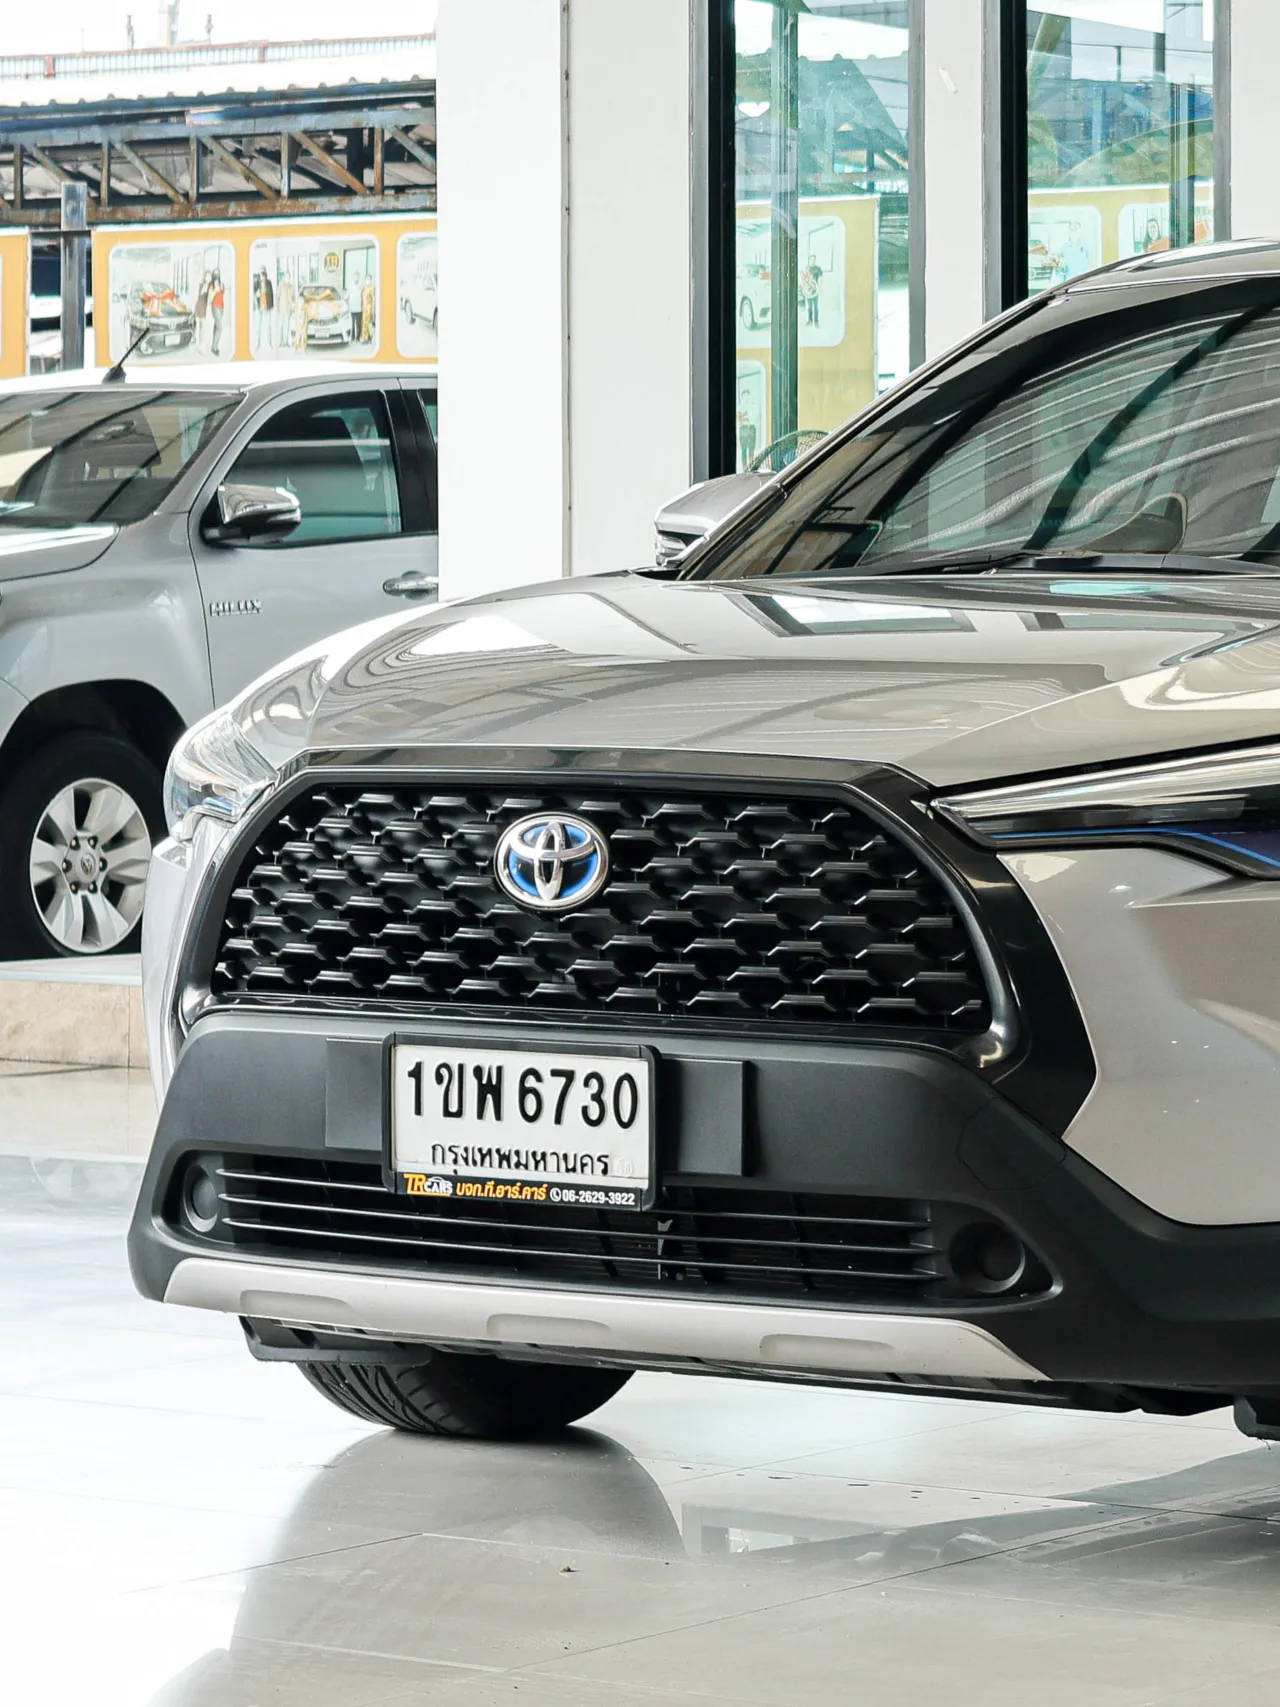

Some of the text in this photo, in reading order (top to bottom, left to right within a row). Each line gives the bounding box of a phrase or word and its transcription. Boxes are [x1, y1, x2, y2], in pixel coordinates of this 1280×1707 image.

[407, 1061, 638, 1129] 1ขพ 6730
[431, 1143, 610, 1175] กรุงเทพมหานคร
[562, 1190, 636, 1206] 06-2629-3922
